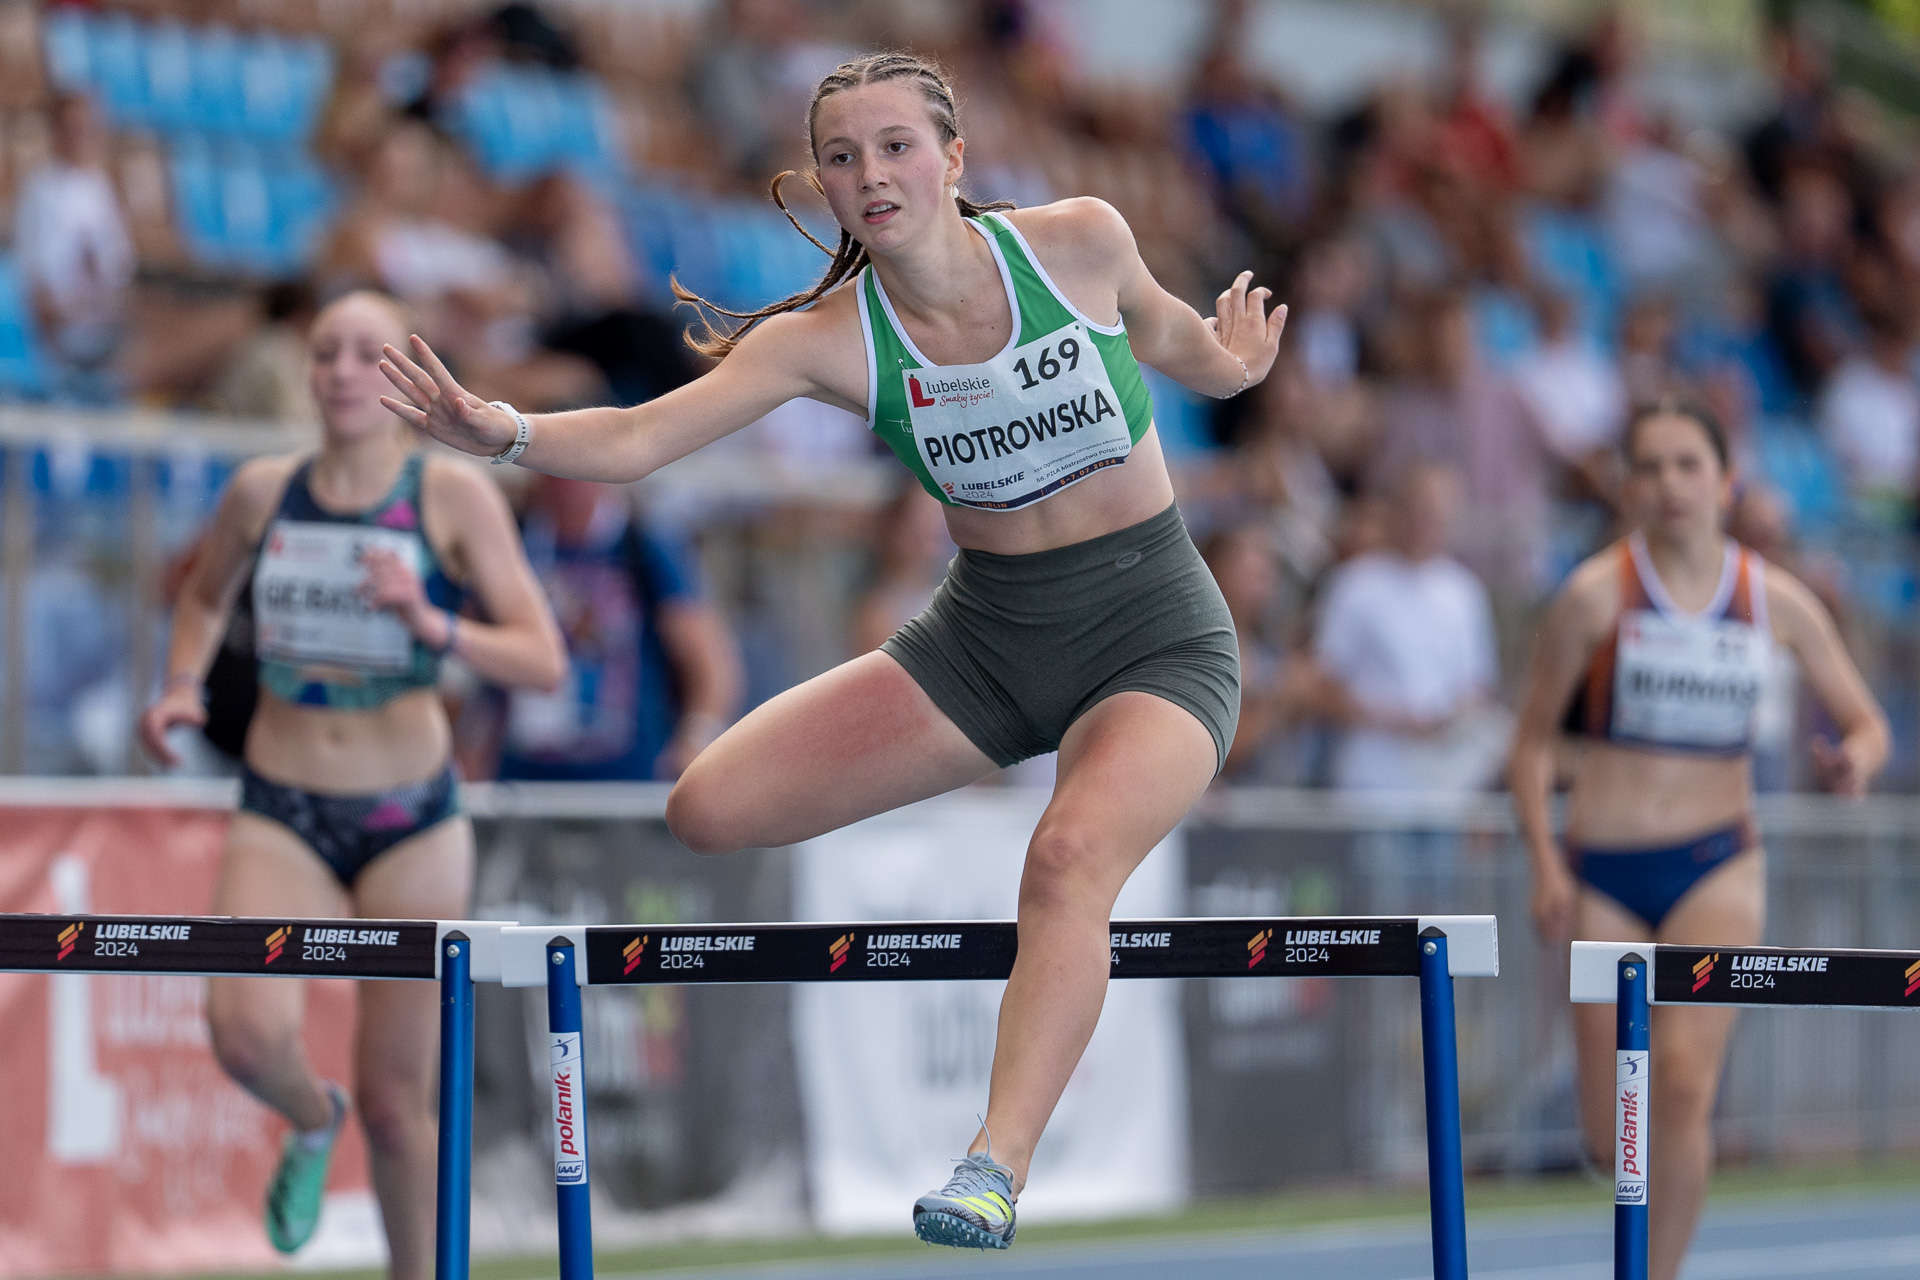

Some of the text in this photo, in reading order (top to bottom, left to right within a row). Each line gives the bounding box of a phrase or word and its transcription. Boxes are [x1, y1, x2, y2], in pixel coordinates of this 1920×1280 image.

[1013, 338, 1080, 390] 169
[926, 377, 991, 394] lubelskie
[939, 389, 994, 408] Smakuj życie!
[924, 388, 1116, 467] PIOTROWSKA
[1046, 469, 1061, 479] PZLA
[1061, 452, 1098, 471] Mistrzostwa
[1098, 446, 1118, 455] Polski
[961, 471, 1025, 491] LUBELSKIE
[964, 490, 994, 499] 2024
[94, 924, 191, 941] LUBELSKIE
[303, 928, 399, 946] LUBELSKIE
[1109, 932, 1171, 948] ELSKIE
[1285, 929, 1381, 945] LUBELSKIE
[94, 942, 139, 956] 2024
[660, 936, 755, 951] LUBELSKIE
[866, 934, 962, 949] LUBELSKIE
[302, 946, 347, 961] 2024
[660, 954, 705, 969] 2024
[866, 952, 911, 967] 2024
[1285, 947, 1330, 962] 2024
[1731, 955, 1829, 972] LUBELSKIE
[1730, 973, 1776, 989] 2024
[558, 1165, 581, 1173] IAAF
[1618, 1185, 1642, 1193] IAAF
